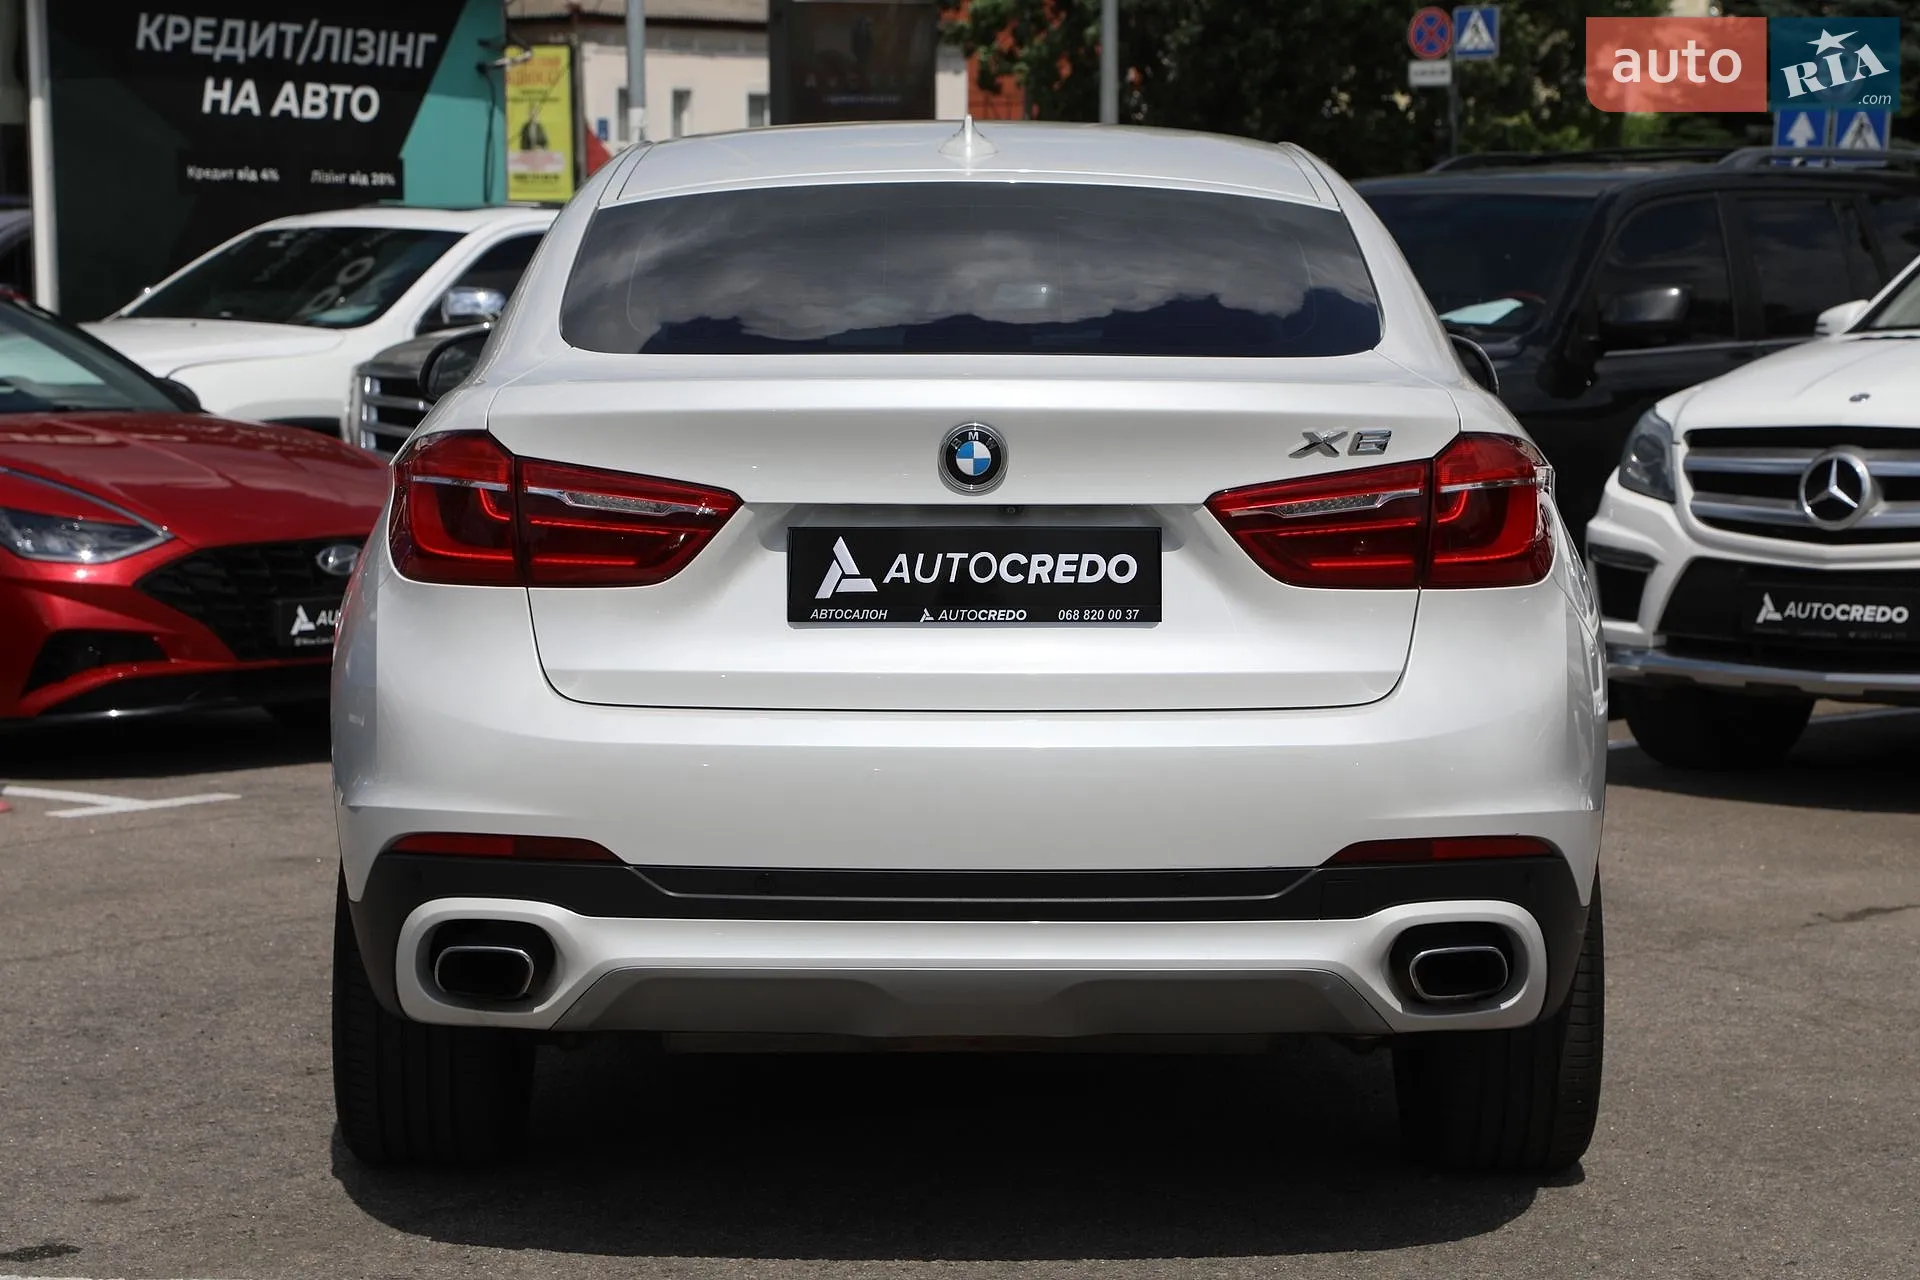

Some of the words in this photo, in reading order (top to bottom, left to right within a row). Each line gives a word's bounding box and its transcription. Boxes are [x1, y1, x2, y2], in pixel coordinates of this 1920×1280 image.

[135, 12, 438, 69] КРЕДИТ/ЛІЗІНГ
[201, 76, 261, 117] НА
[269, 80, 380, 123] АВТО
[186, 164, 234, 182] Кредит
[951, 431, 997, 450] BMW
[1287, 429, 1392, 459] X6
[883, 551, 1138, 585] AUTOCREDO
[810, 608, 888, 621] АВТОСАЛОН
[937, 607, 1028, 622] AUTOCREDO
[1057, 609, 1080, 622] 068
[1082, 609, 1105, 622] 820
[1107, 609, 1123, 621] 00
[1125, 608, 1140, 621] 37
[1783, 600, 1910, 624] AUTOCREDO
